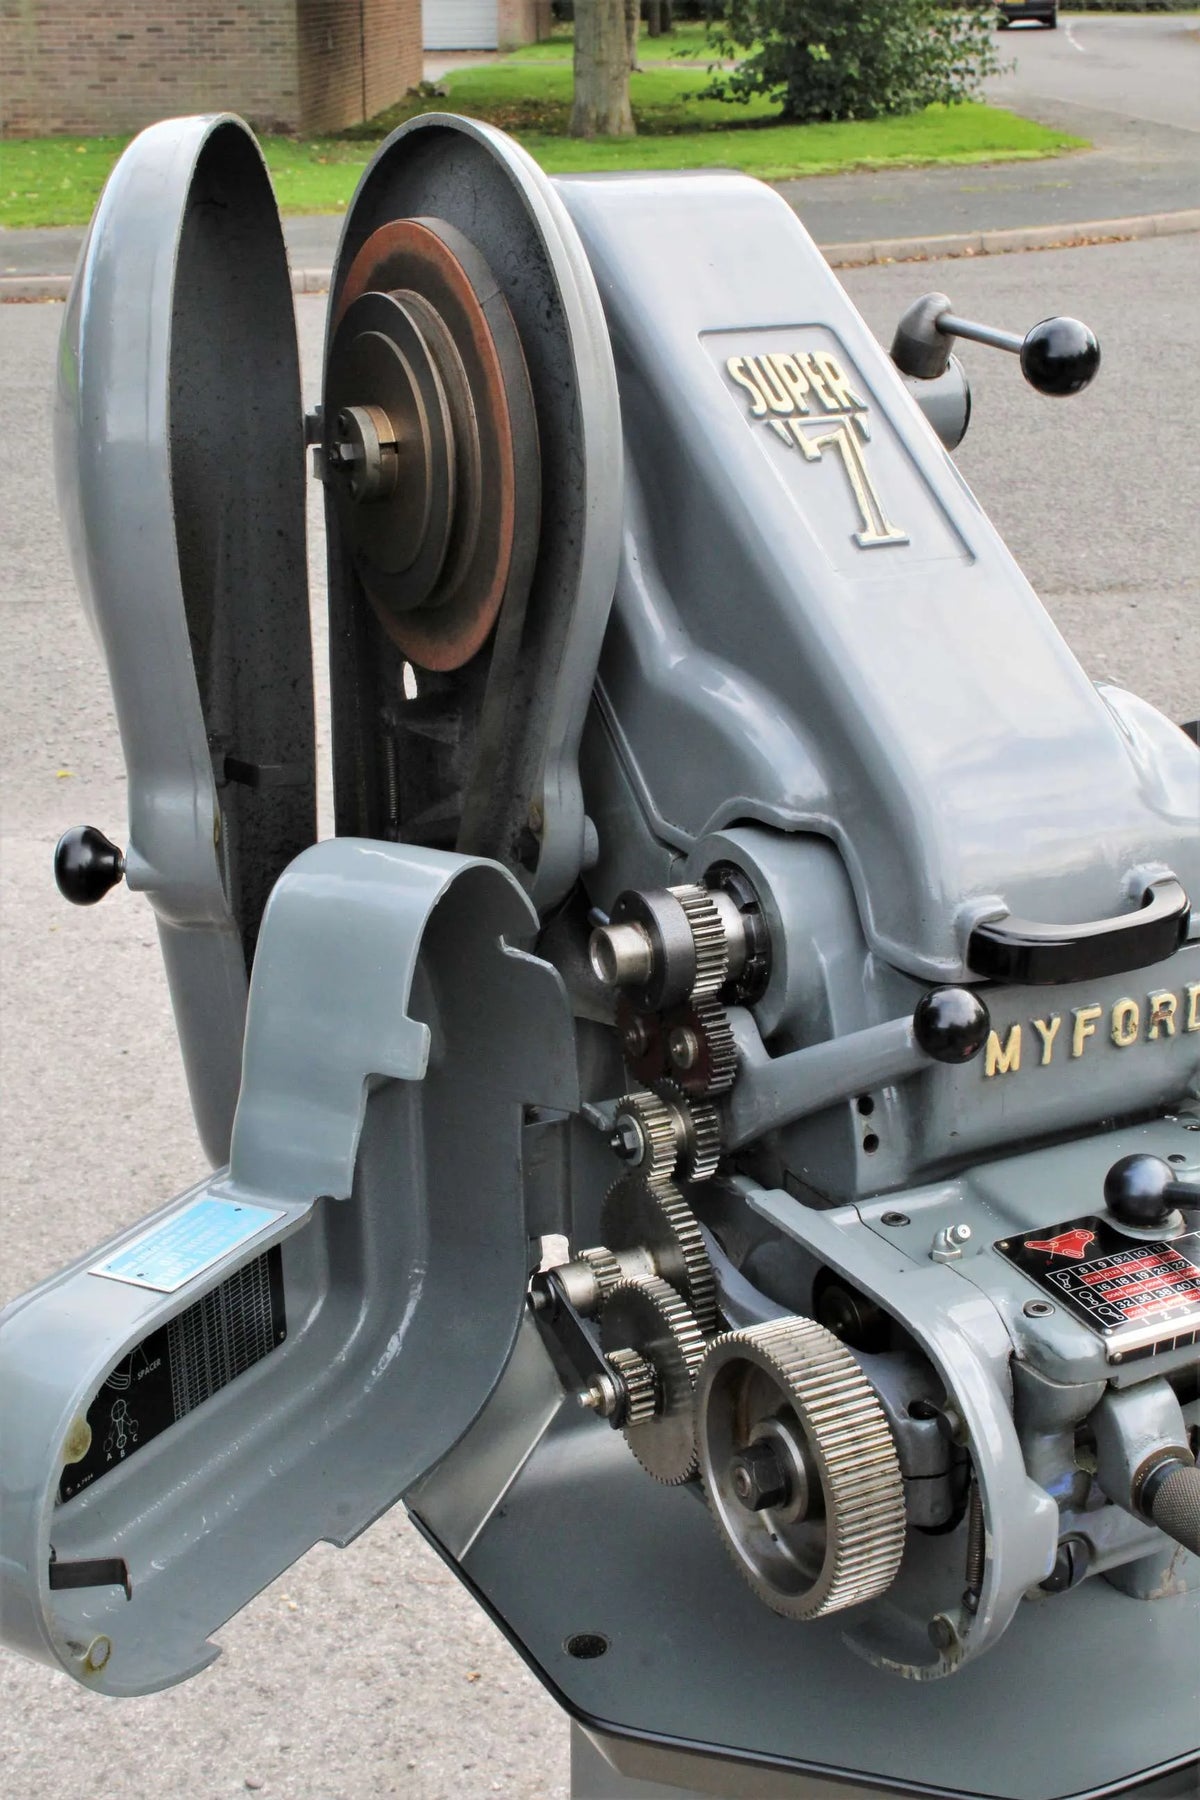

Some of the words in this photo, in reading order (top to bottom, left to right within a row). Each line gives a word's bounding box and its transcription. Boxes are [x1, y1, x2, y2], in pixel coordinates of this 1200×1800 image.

[726, 350, 868, 416] SUPER
[1078, 1266, 1089, 1274] 8
[1133, 1250, 1148, 1258] 10
[1097, 1283, 1111, 1291] 16
[1115, 1277, 1130, 1286] 18
[1136, 1271, 1150, 1280] 19
[1153, 1266, 1170, 1275] 20
[1116, 1299, 1134, 1309] 32
[1135, 1293, 1153, 1303] 36
[1155, 1288, 1173, 1297] 38
[1176, 1282, 1191, 1291] 40
[1141, 1317, 1151, 1326] 1
[1160, 1311, 1172, 1320] 2
[1180, 1305, 1191, 1315] 3
[137, 1358, 161, 1381] SPACER
